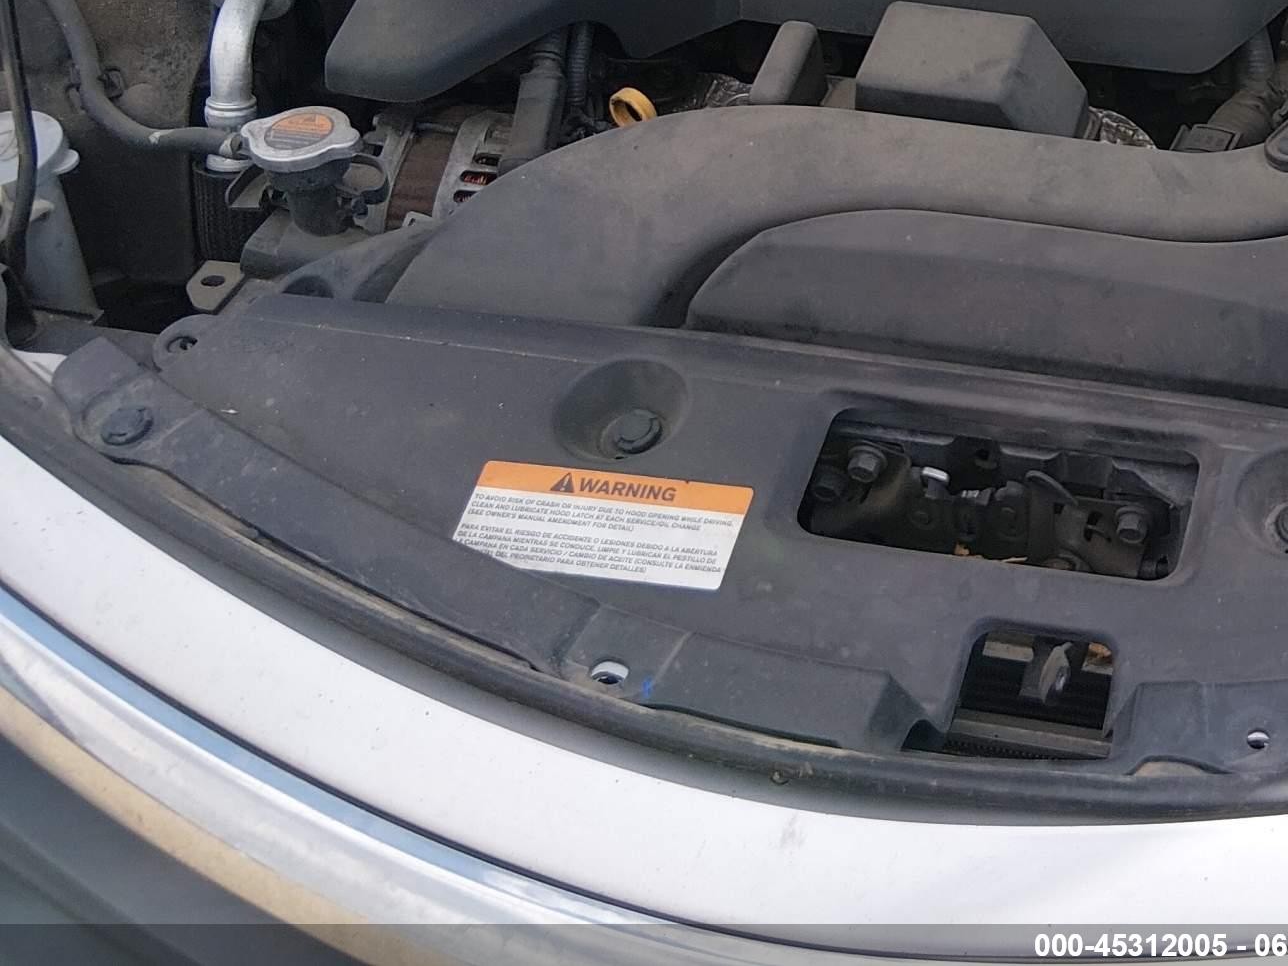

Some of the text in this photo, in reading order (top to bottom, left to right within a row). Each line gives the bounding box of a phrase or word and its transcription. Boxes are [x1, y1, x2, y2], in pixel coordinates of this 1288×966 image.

[580, 477, 677, 501] WARNING
[511, 505, 548, 513] LUBRICATE
[671, 522, 701, 530] CHANGE
[517, 513, 546, 521] MANUAL
[547, 517, 591, 526] AMENDMENT
[535, 499, 560, 507] CRASH
[572, 503, 596, 511] INJURY
[647, 512, 680, 520] OPENING
[681, 515, 703, 523] WHILE
[478, 532, 512, 541] CAMPANA
[512, 536, 548, 545] MIENTRAS
[672, 554, 706, 563] PESTILLO
[552, 533, 592, 542] ACCIDENTE
[600, 538, 635, 547] LESIONES
[635, 542, 663, 550] DEBIDO
[680, 547, 718, 556] ABERTURA
[529, 546, 563, 554] SERVICIO
[568, 550, 597, 558] CAMBIO
[608, 554, 634, 562] ACEITE
[684, 563, 722, 572] ENMIENDA
[555, 557, 575, 565] PARA
[575, 559, 609, 568] OBTENER
